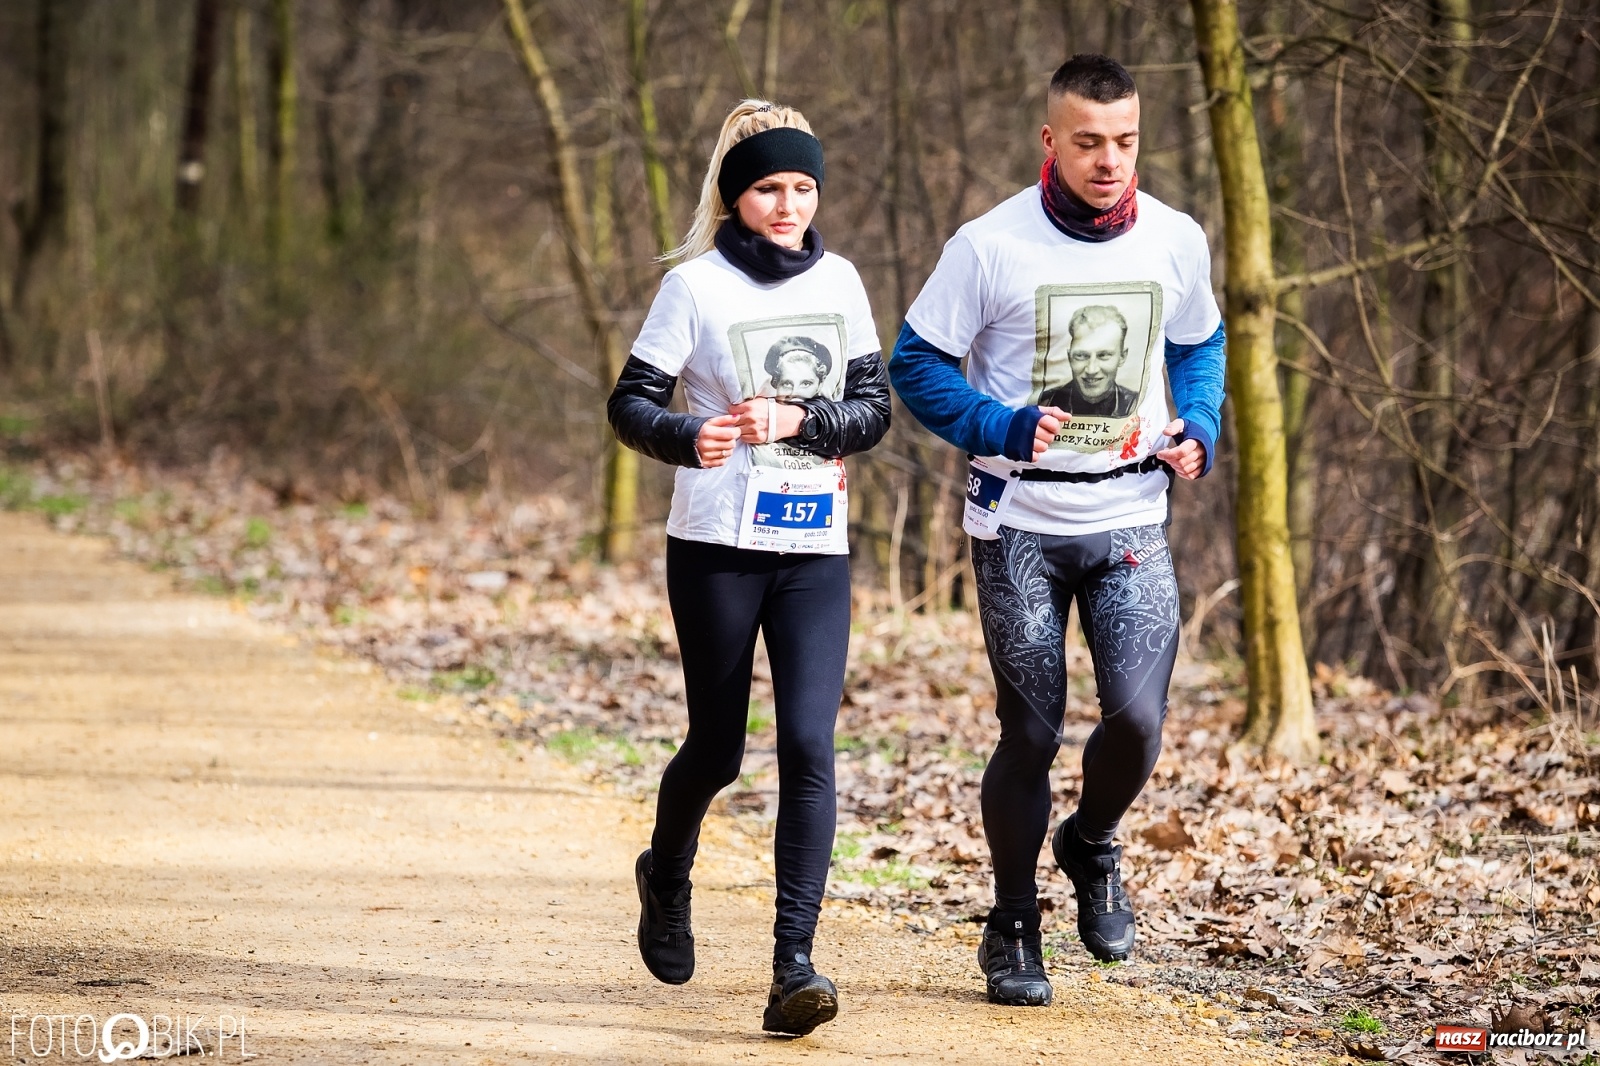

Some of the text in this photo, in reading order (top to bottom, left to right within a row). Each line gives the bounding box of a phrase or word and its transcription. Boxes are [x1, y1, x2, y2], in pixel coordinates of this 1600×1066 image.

[1062, 420, 1111, 434] Henryk
[783, 459, 812, 470] Golec
[781, 501, 818, 522] 157
[753, 526, 770, 535] 1963
